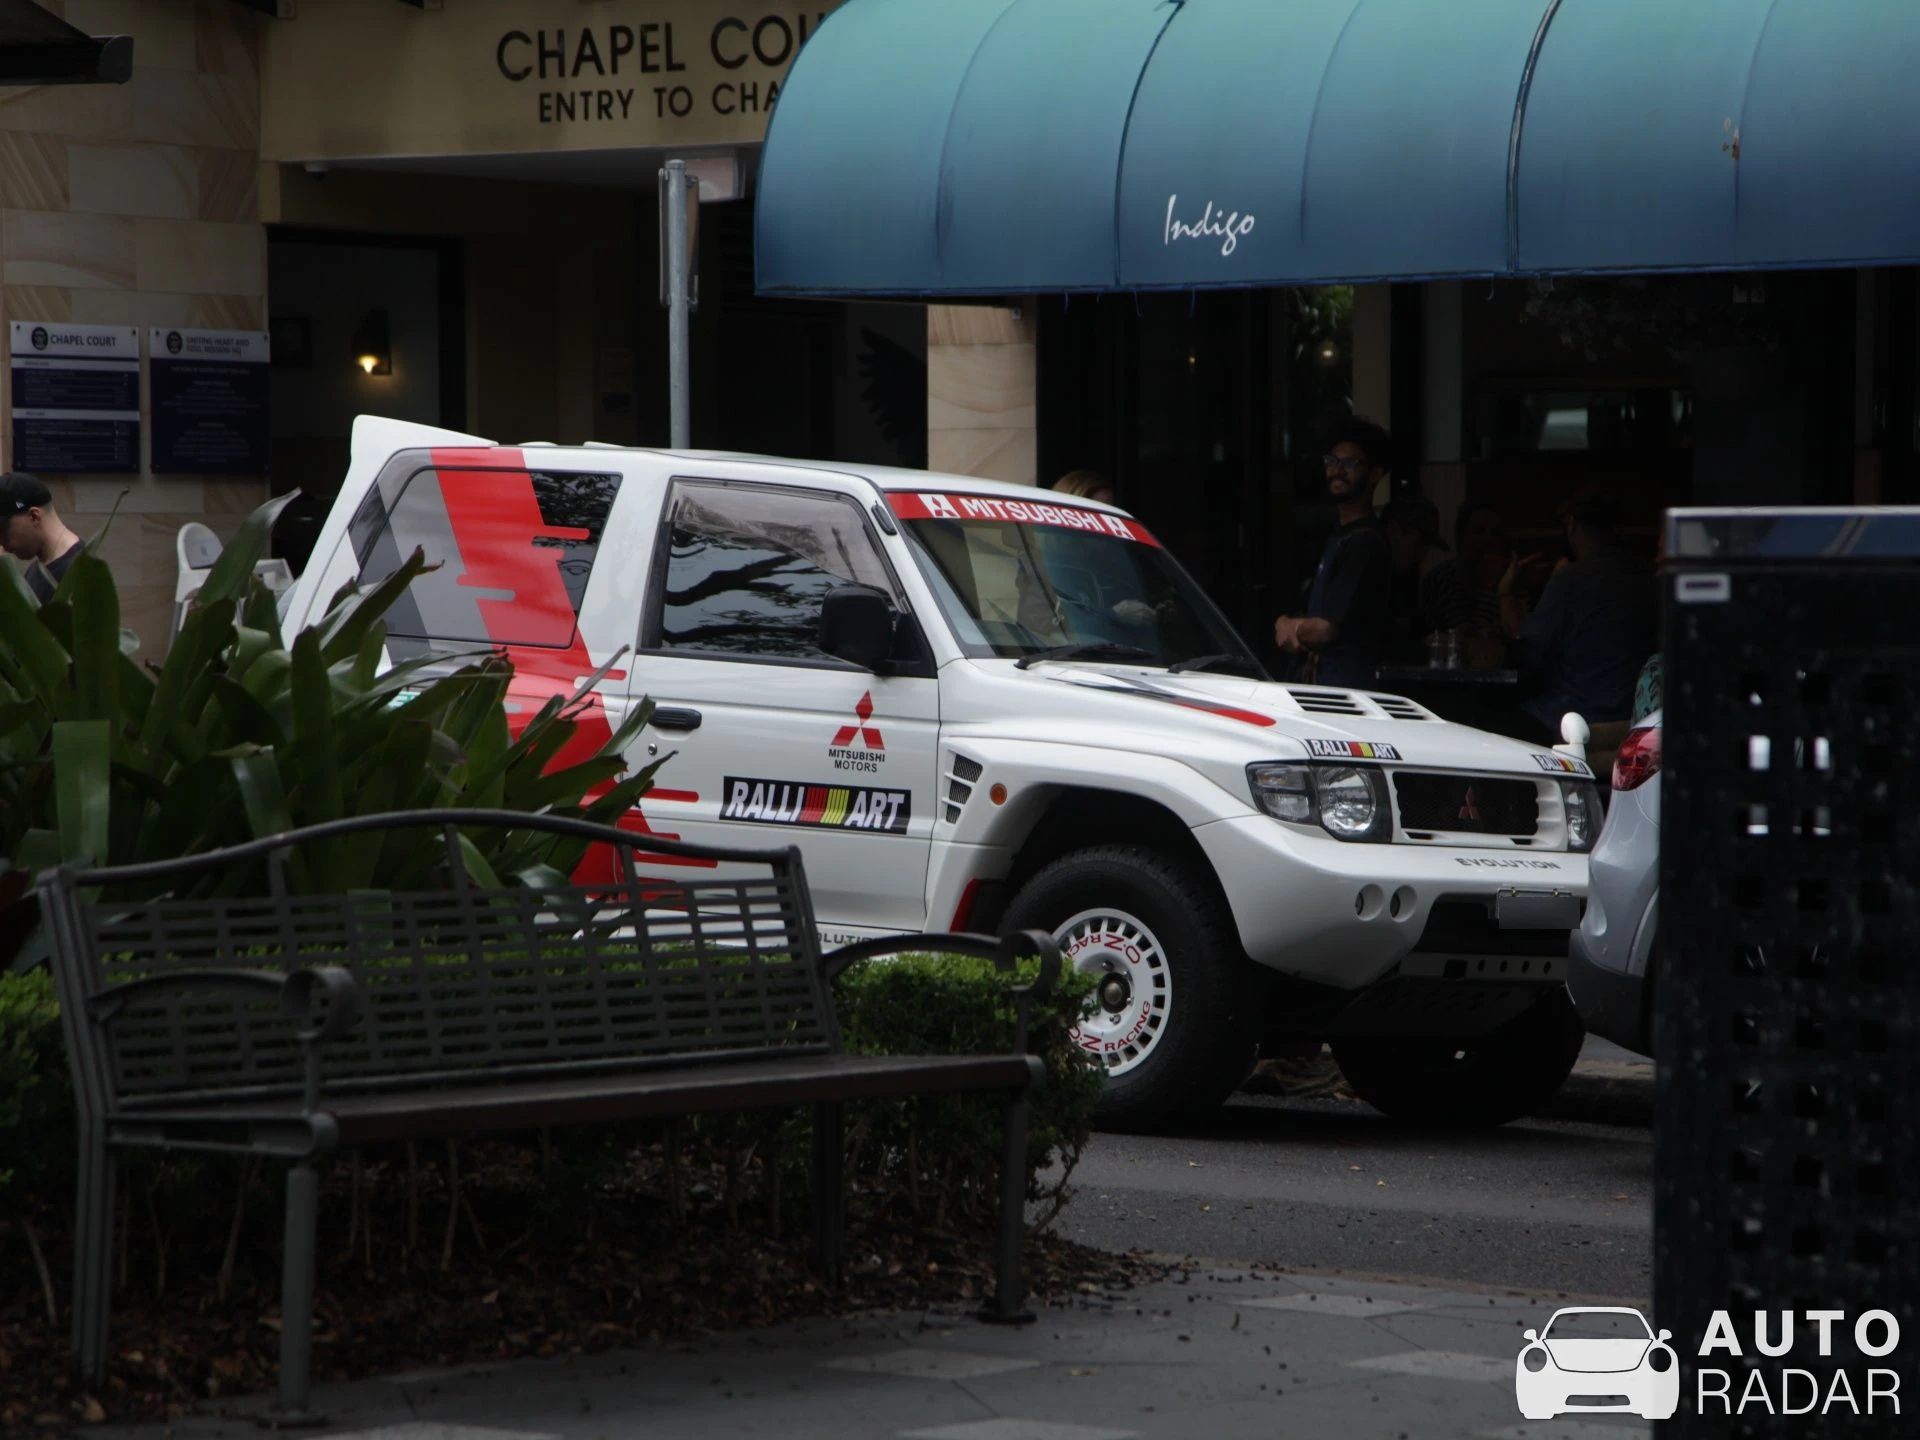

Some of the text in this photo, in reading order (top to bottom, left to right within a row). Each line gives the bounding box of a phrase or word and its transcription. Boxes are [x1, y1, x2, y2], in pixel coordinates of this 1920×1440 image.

[497, 22, 686, 82] CHAPEL
[539, 89, 635, 123] ENTRY
[652, 85, 694, 118] TO
[1165, 193, 1255, 256] Indigo
[50, 334, 117, 347] CHAPEL COURT
[959, 497, 1105, 533] MITSUBISHI
[828, 749, 886, 763] MITSUBISHI
[1310, 739, 1353, 757] RALLI
[834, 760, 878, 773] MOTORS
[725, 780, 905, 830] RALLI ART
[1454, 857, 1561, 870] EVOLUTION
[1104, 1000, 1151, 1052] RACING
